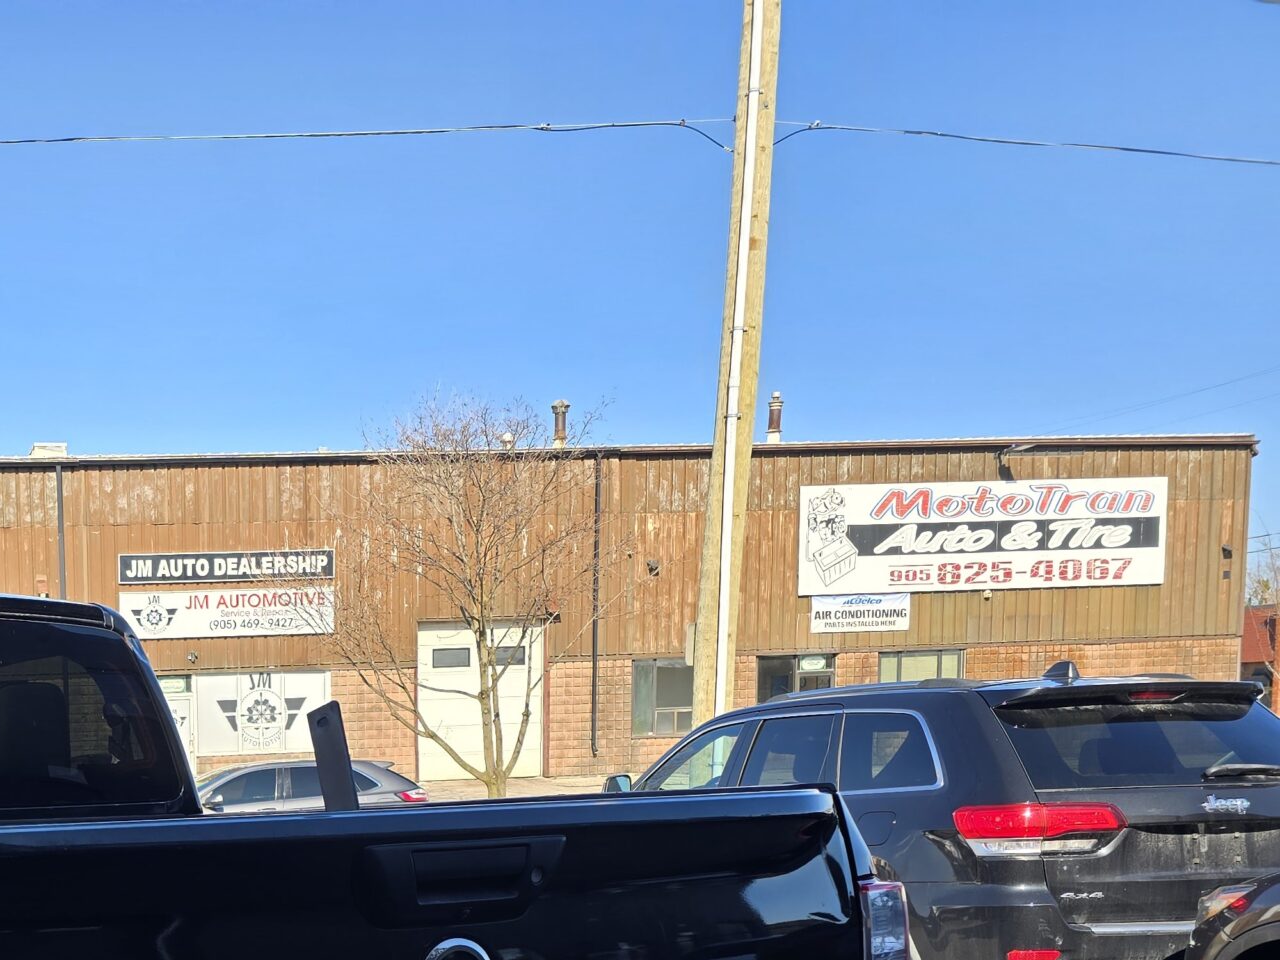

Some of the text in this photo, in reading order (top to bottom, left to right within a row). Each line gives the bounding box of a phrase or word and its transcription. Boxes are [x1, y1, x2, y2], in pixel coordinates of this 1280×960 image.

[870, 484, 1155, 520] MotoTran
[874, 519, 1132, 554] Auto & Tire
[126, 555, 328, 578] JM AUTO DEALERSHIP
[889, 558, 1132, 585] 905 825-4067
[185, 591, 325, 610] JM AUTOMOTIVE
[220, 609, 251, 617] Service
[814, 608, 907, 620] AIR CONDITIONING
[209, 619, 237, 631] (905)
[845, 620, 879, 628] INSTALLED
[249, 672, 271, 690] JM
[1201, 793, 1251, 815] Jeep
